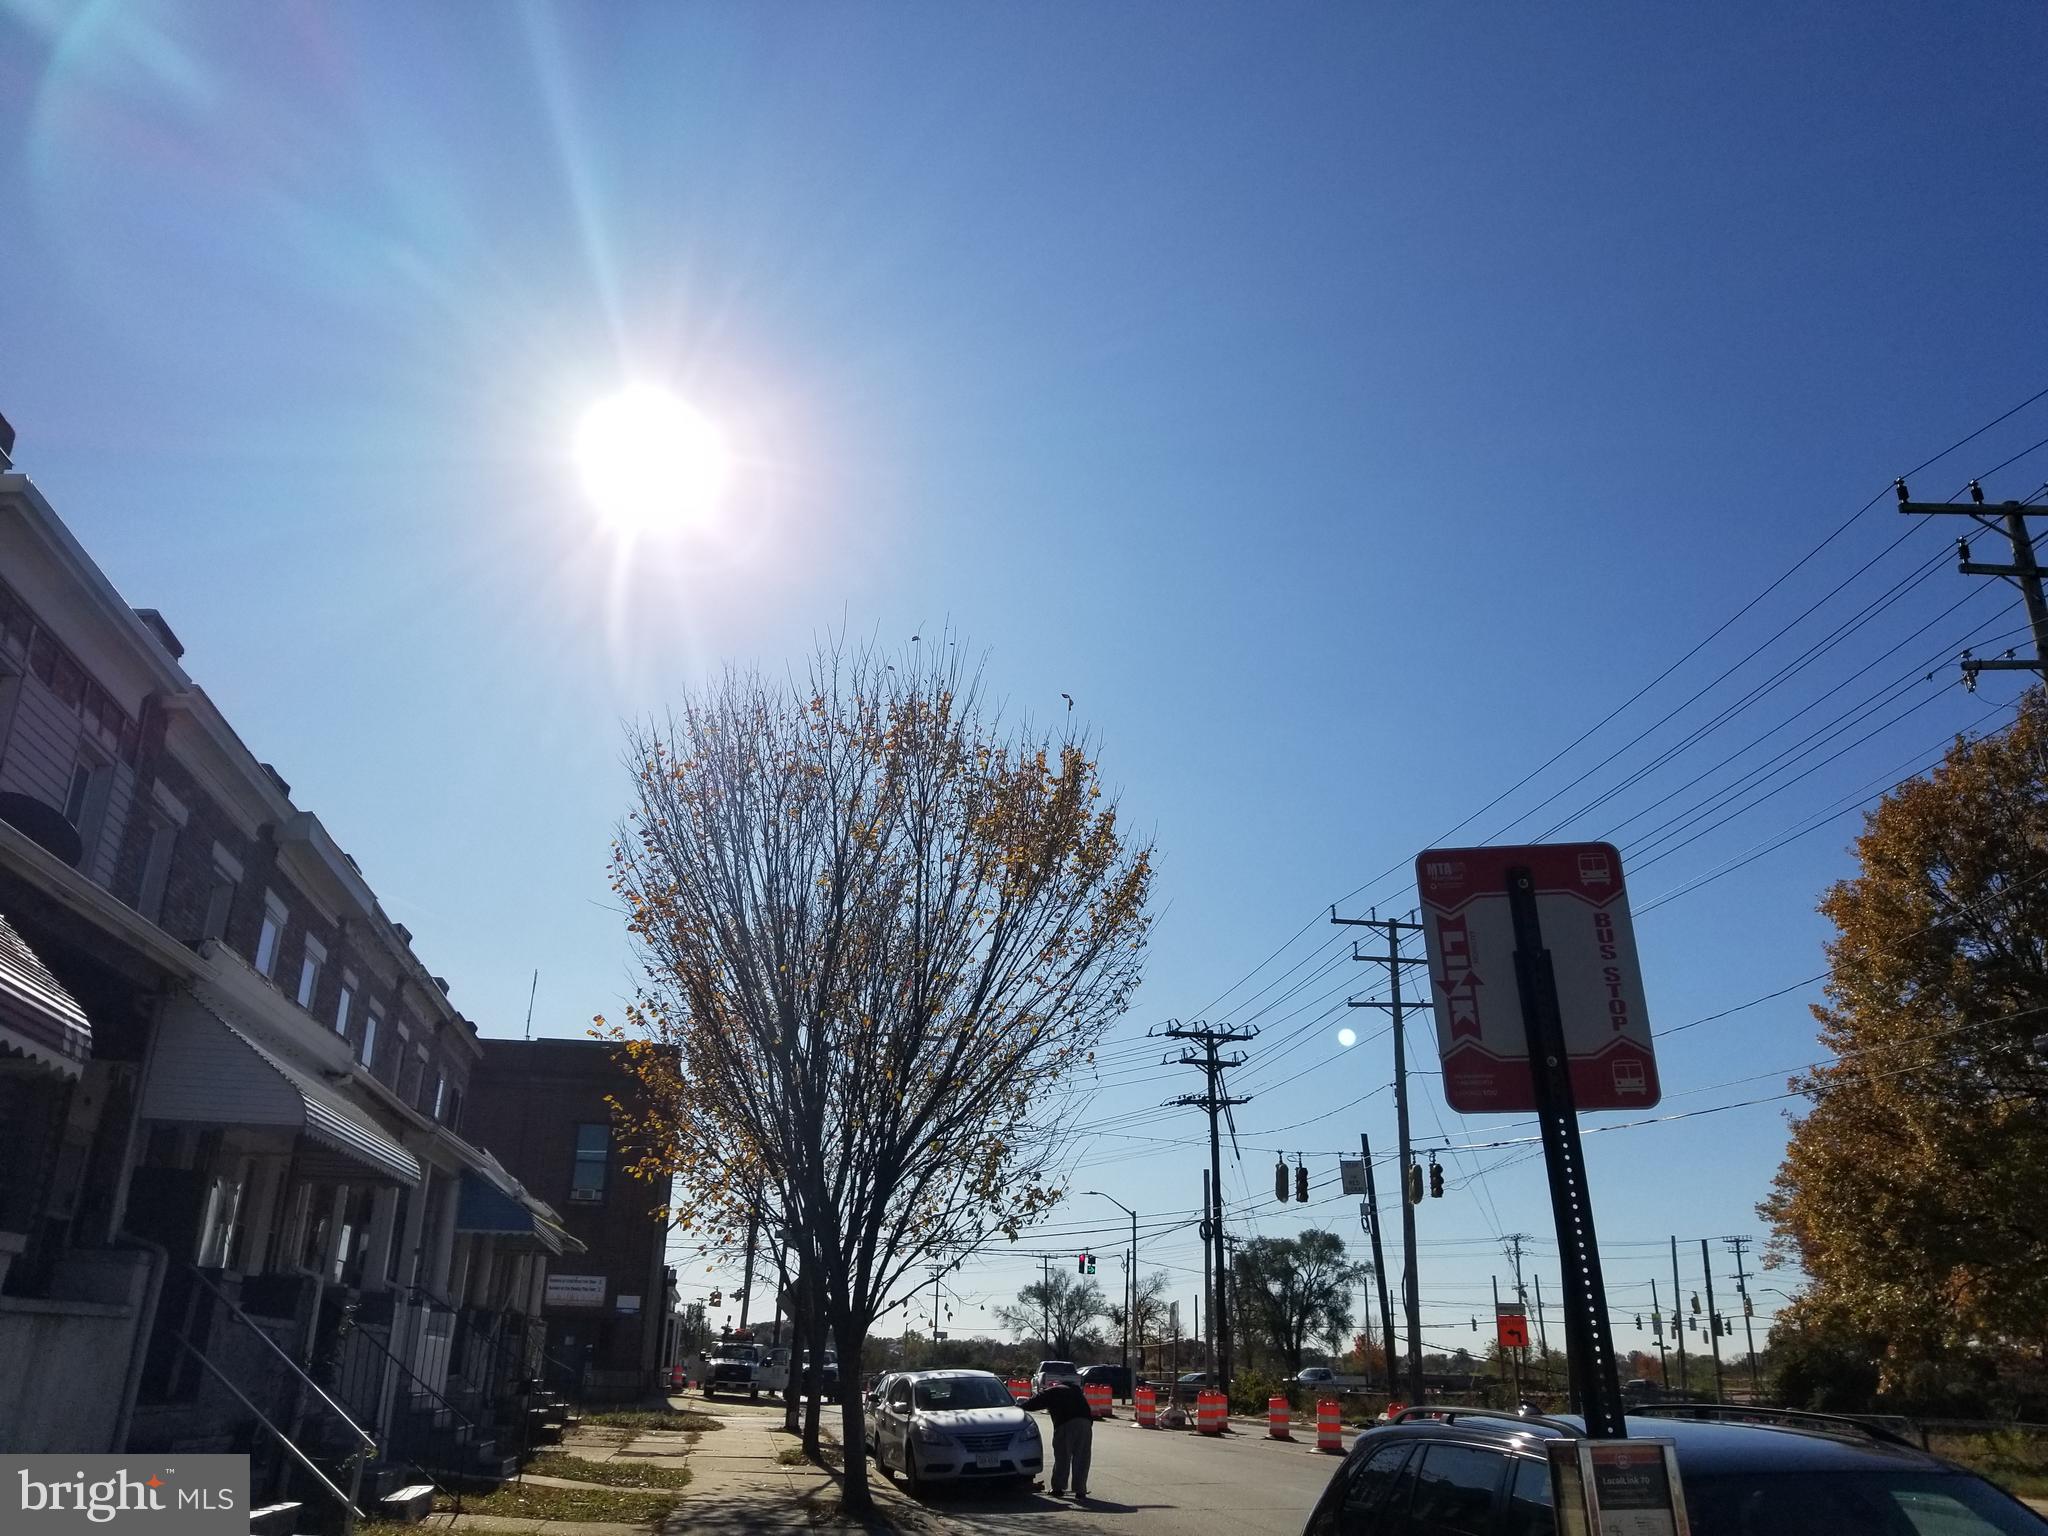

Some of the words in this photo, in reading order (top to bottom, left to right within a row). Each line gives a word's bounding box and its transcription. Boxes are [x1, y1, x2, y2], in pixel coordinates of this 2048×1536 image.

[1426, 862, 1452, 877] MTA
[1594, 912, 1617, 960] BUS
[1442, 931, 1477, 1027] LINK
[1603, 967, 1628, 1031] STOP
